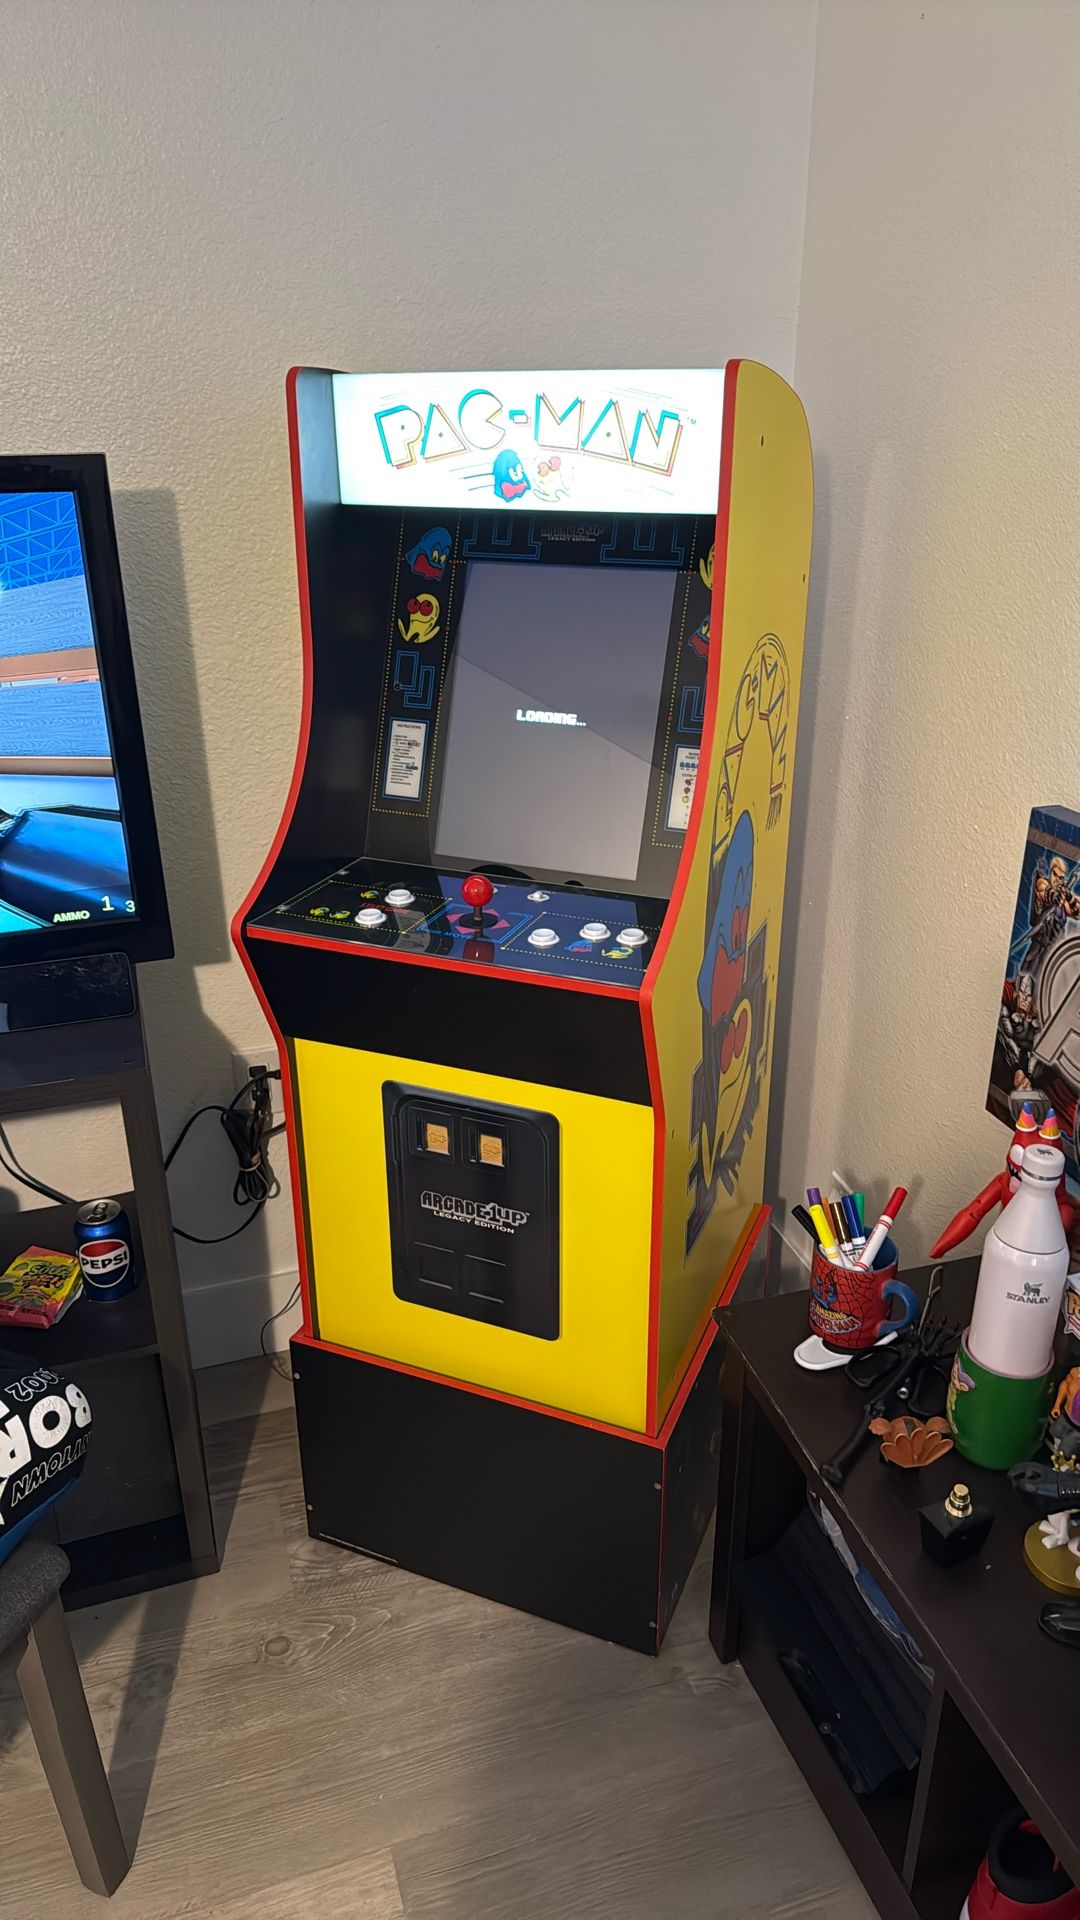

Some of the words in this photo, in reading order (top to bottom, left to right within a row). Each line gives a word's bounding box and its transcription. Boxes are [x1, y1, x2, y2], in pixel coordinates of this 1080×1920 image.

[374, 388, 684, 477] PAC-MAN
[53, 910, 90, 923] AMMO
[101, 895, 115, 911] 1
[125, 900, 136, 912] 3
[433, 1210, 472, 1224] LEGACY
[474, 1220, 515, 1234] EDITION
[80, 1250, 128, 1269] PEPSI
[1005, 1291, 1051, 1305] STANLEY
